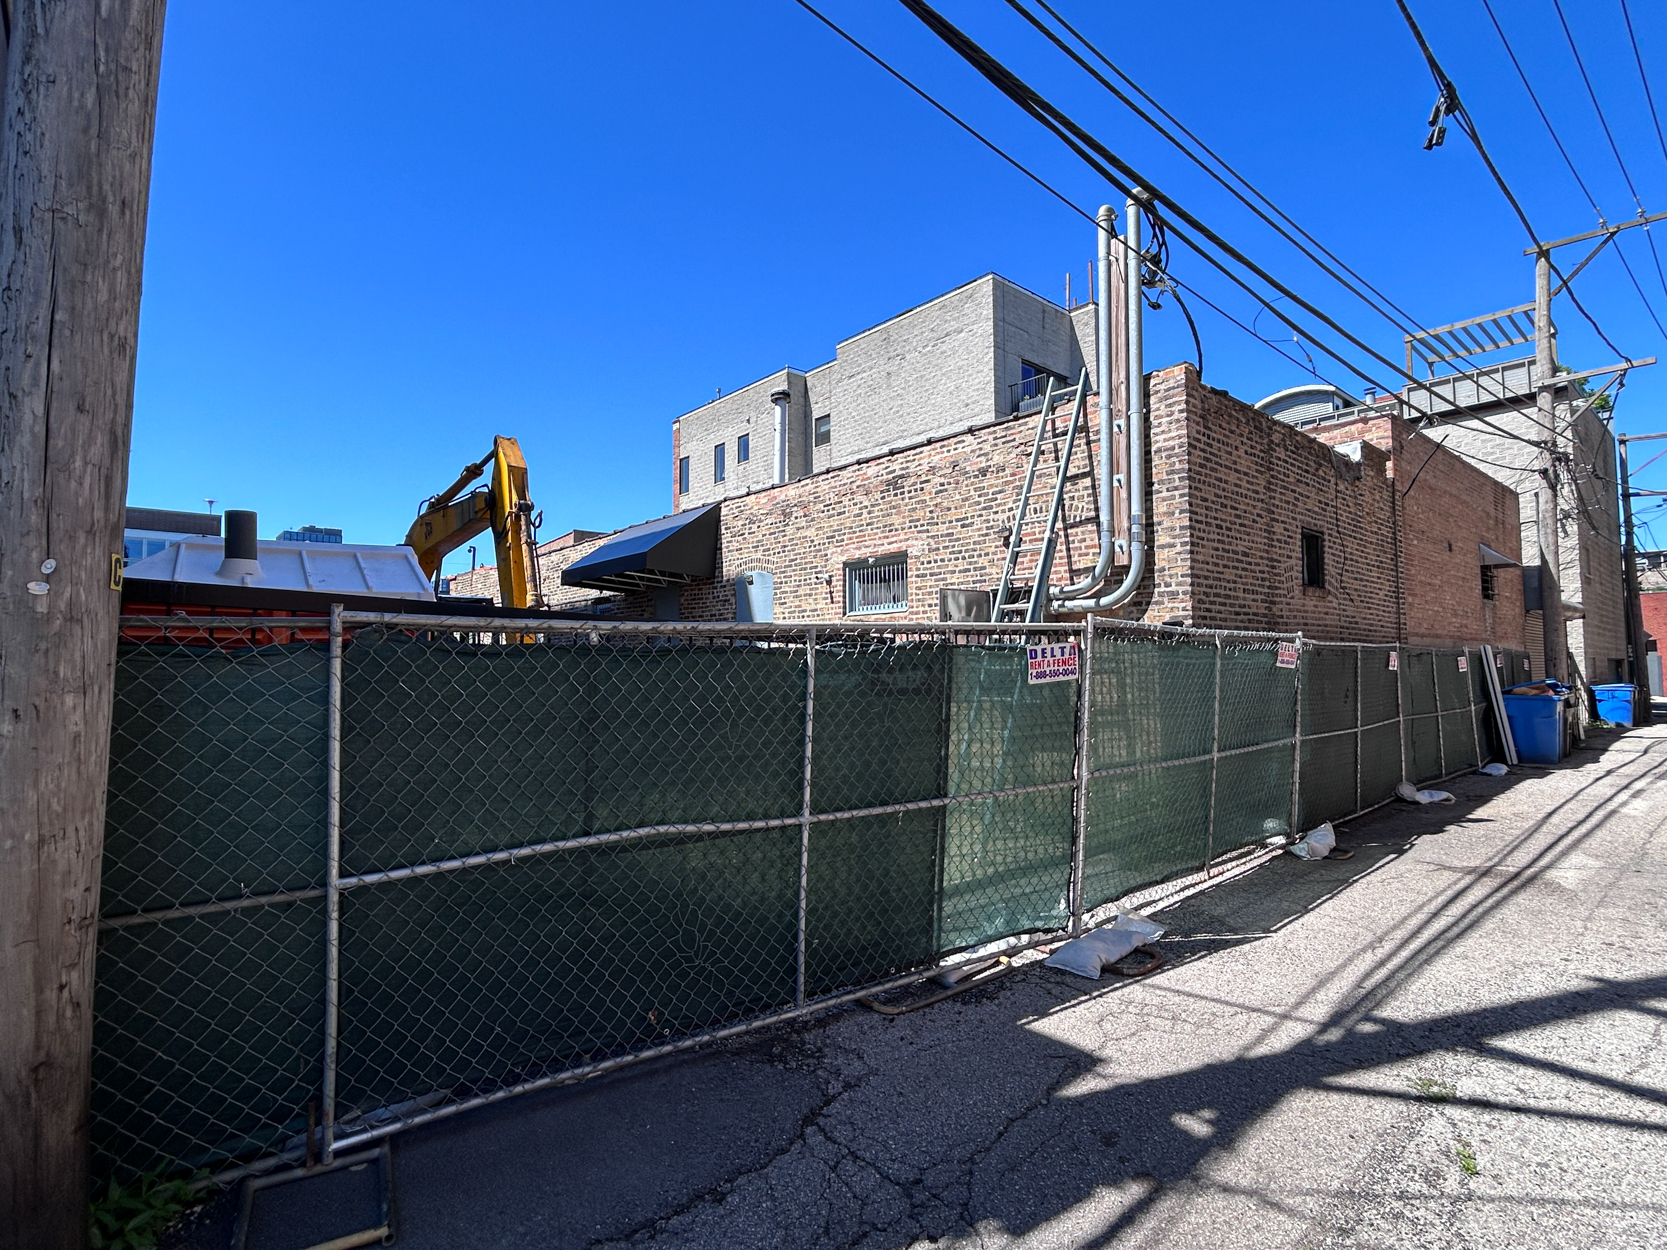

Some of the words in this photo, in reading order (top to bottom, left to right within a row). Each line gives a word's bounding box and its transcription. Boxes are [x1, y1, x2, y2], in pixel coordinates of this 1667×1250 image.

[114, 557, 122, 587] C
[1029, 646, 1077, 660] DELTA
[1030, 668, 1077, 680] 1-888-550-0040
